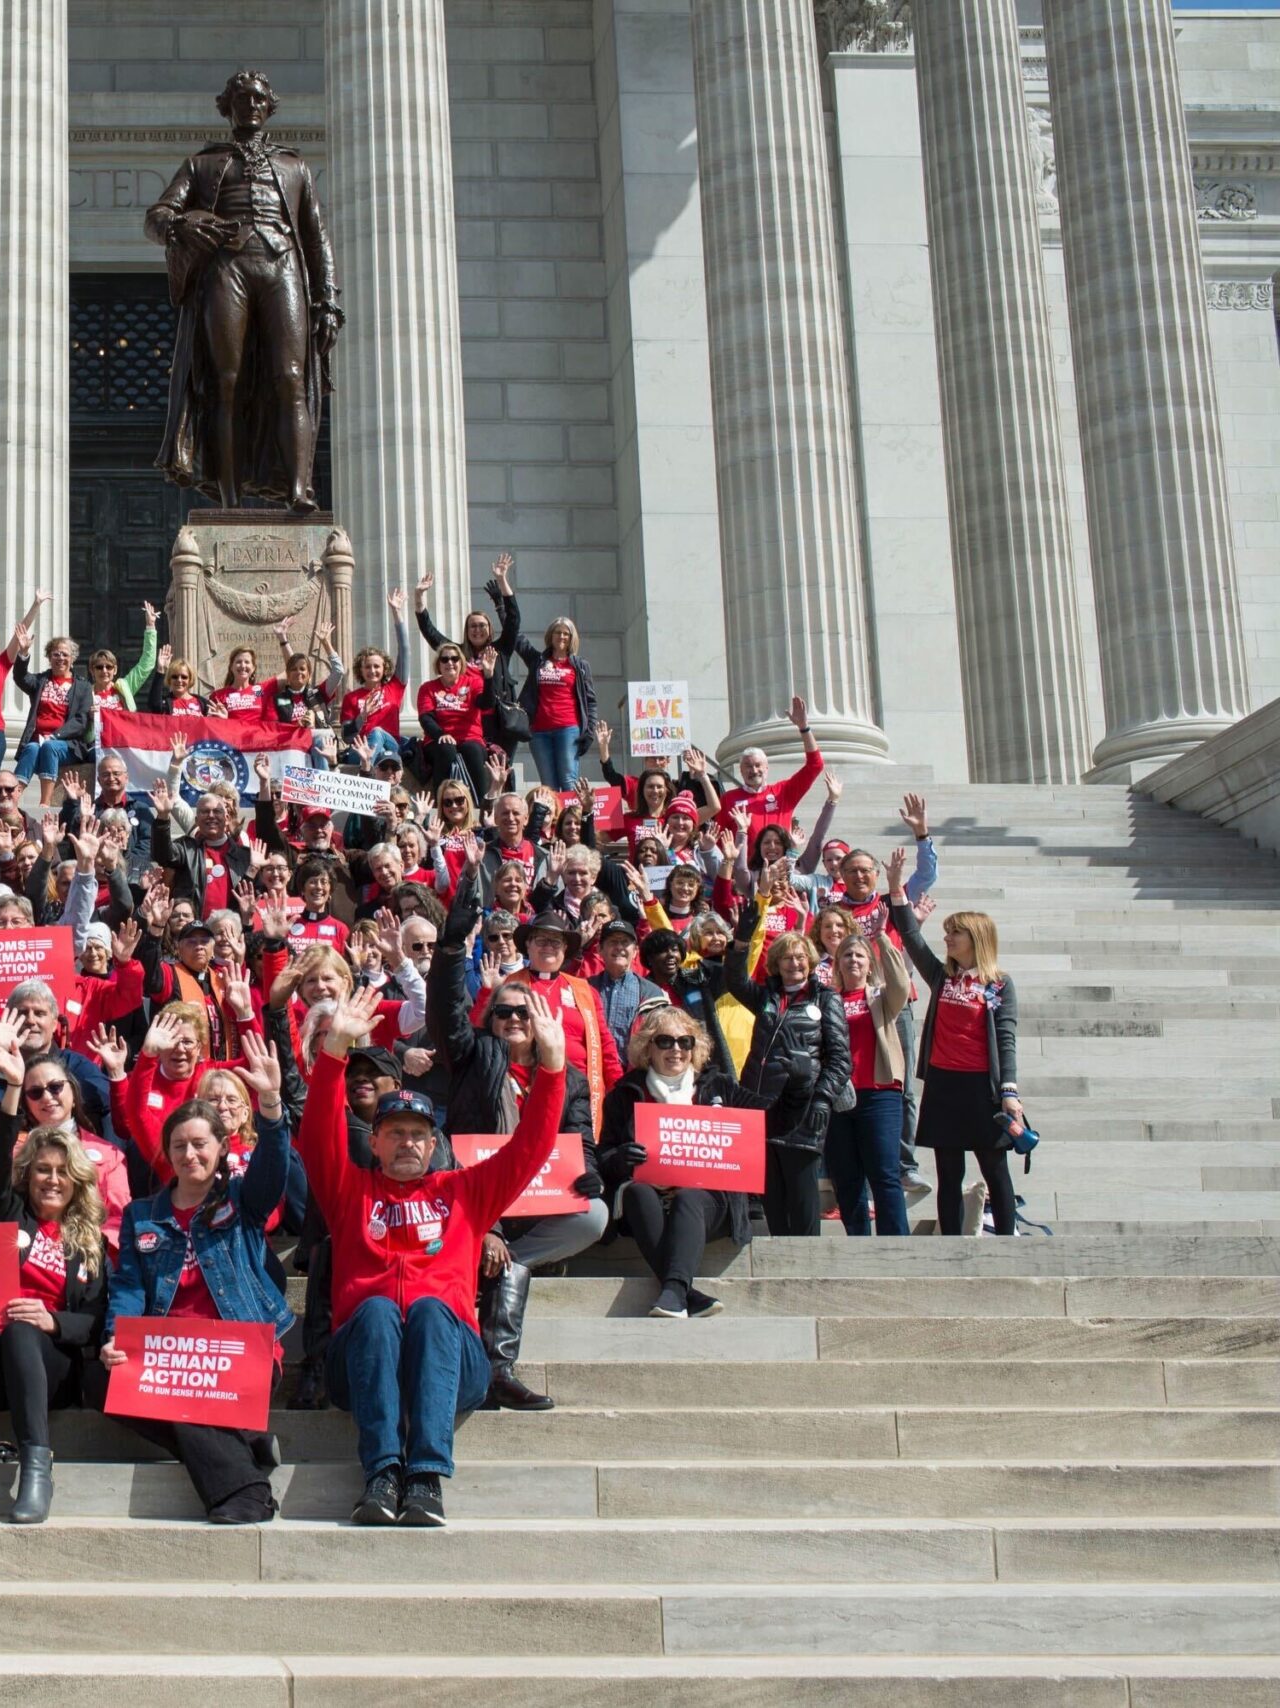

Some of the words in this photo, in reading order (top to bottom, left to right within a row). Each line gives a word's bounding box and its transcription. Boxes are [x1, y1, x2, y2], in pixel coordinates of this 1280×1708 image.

[232, 547, 295, 563] PATRIA
[217, 632, 258, 642] THOMAS
[635, 698, 683, 720] LOVE
[632, 743, 657, 754] MORE
[290, 780, 335, 795] WANTING
[336, 787, 383, 802] COMMON
[318, 775, 342, 784] GUN
[344, 778, 383, 792] OWNER
[290, 790, 322, 804] SENSE
[324, 796, 349, 808] GUN
[352, 801, 375, 811] LAW
[592, 1069, 600, 1086] the
[659, 1117, 711, 1132] MOMS
[659, 1130, 733, 1147] DEMAND
[660, 1144, 723, 1160] ACTION
[673, 1159, 685, 1167] GUN
[686, 1160, 705, 1168] SENSE
[713, 1162, 741, 1171] AMERICA
[370, 1199, 449, 1227] CDINALS
[30, 1248, 65, 1269] TION
[144, 1335, 208, 1353] MOMS
[143, 1351, 232, 1371] DEMAND
[140, 1368, 218, 1388] ACTION
[138, 1384, 153, 1394] FOR
[155, 1386, 170, 1395] GUN
[171, 1388, 194, 1398] SENSE
[195, 1390, 203, 1398] IN
[204, 1391, 239, 1401] AMERICA
